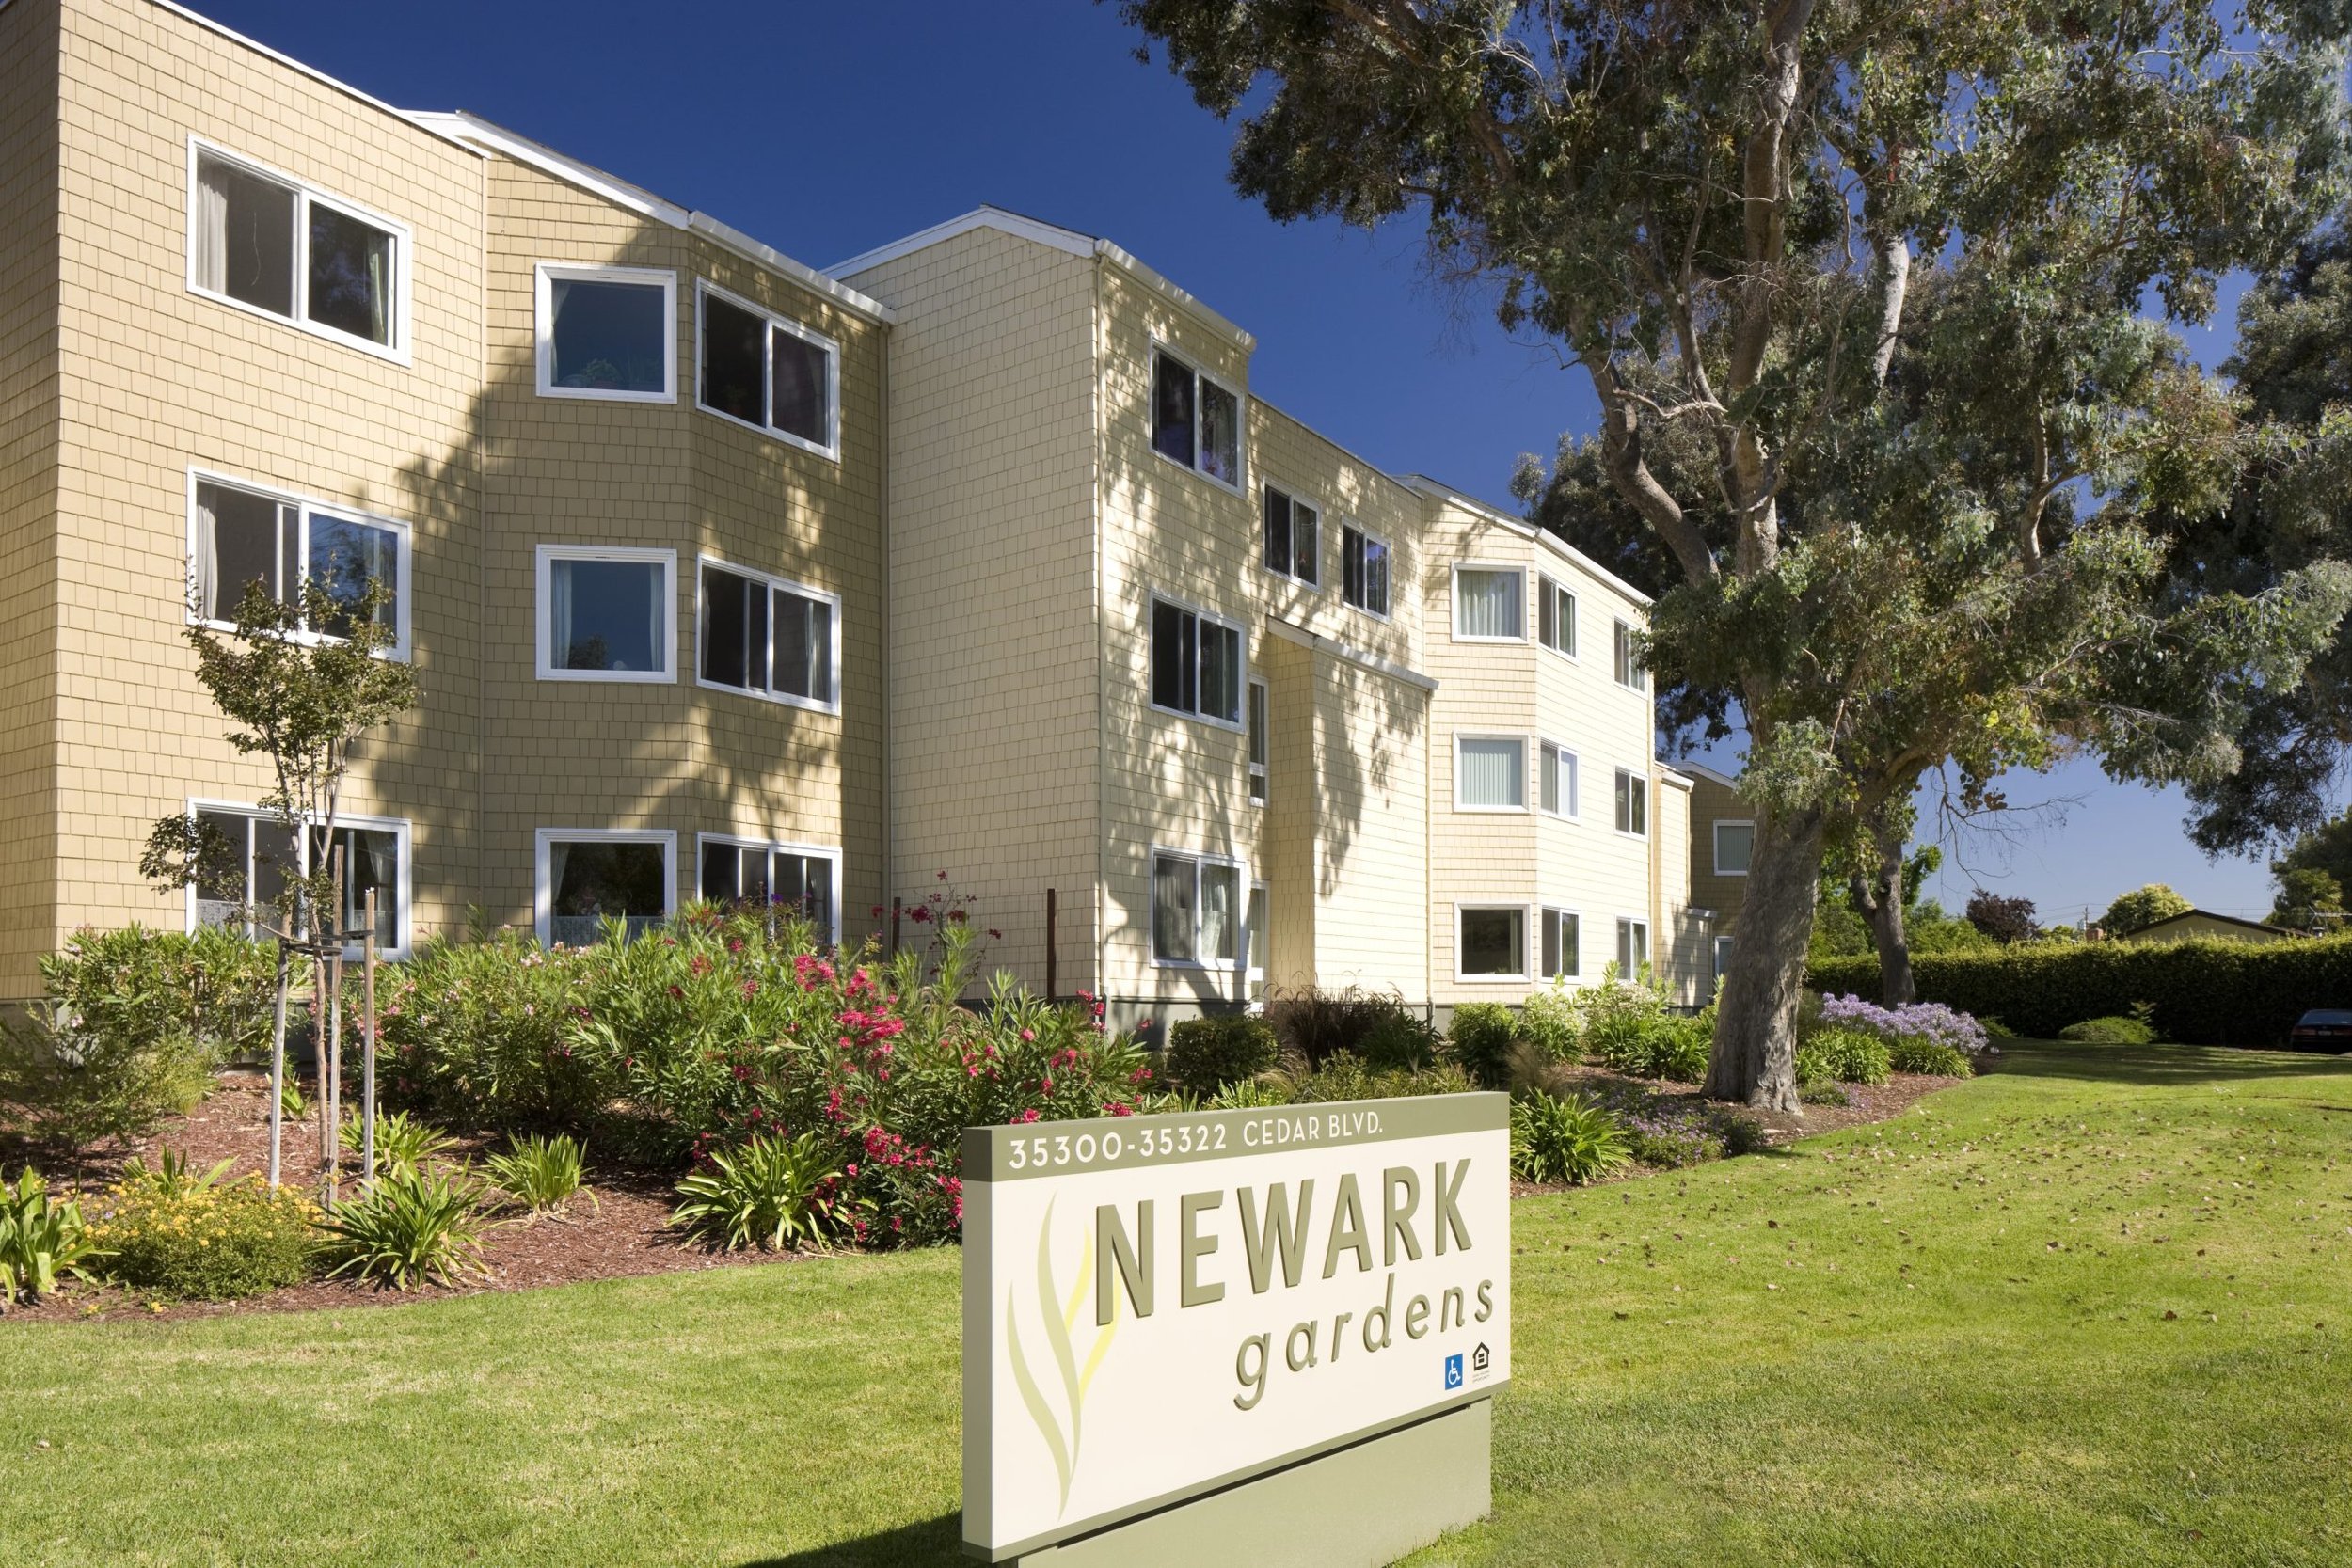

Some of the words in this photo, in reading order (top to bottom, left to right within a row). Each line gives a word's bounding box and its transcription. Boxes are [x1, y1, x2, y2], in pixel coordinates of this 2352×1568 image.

[1009, 1123, 1227, 1169] 35300-35322
[1243, 1117, 1319, 1148] CEDAR
[1328, 1111, 1384, 1138] BLVD.
[1095, 1158, 1472, 1326] NEWARK
[1233, 1273, 1492, 1409] gardens
